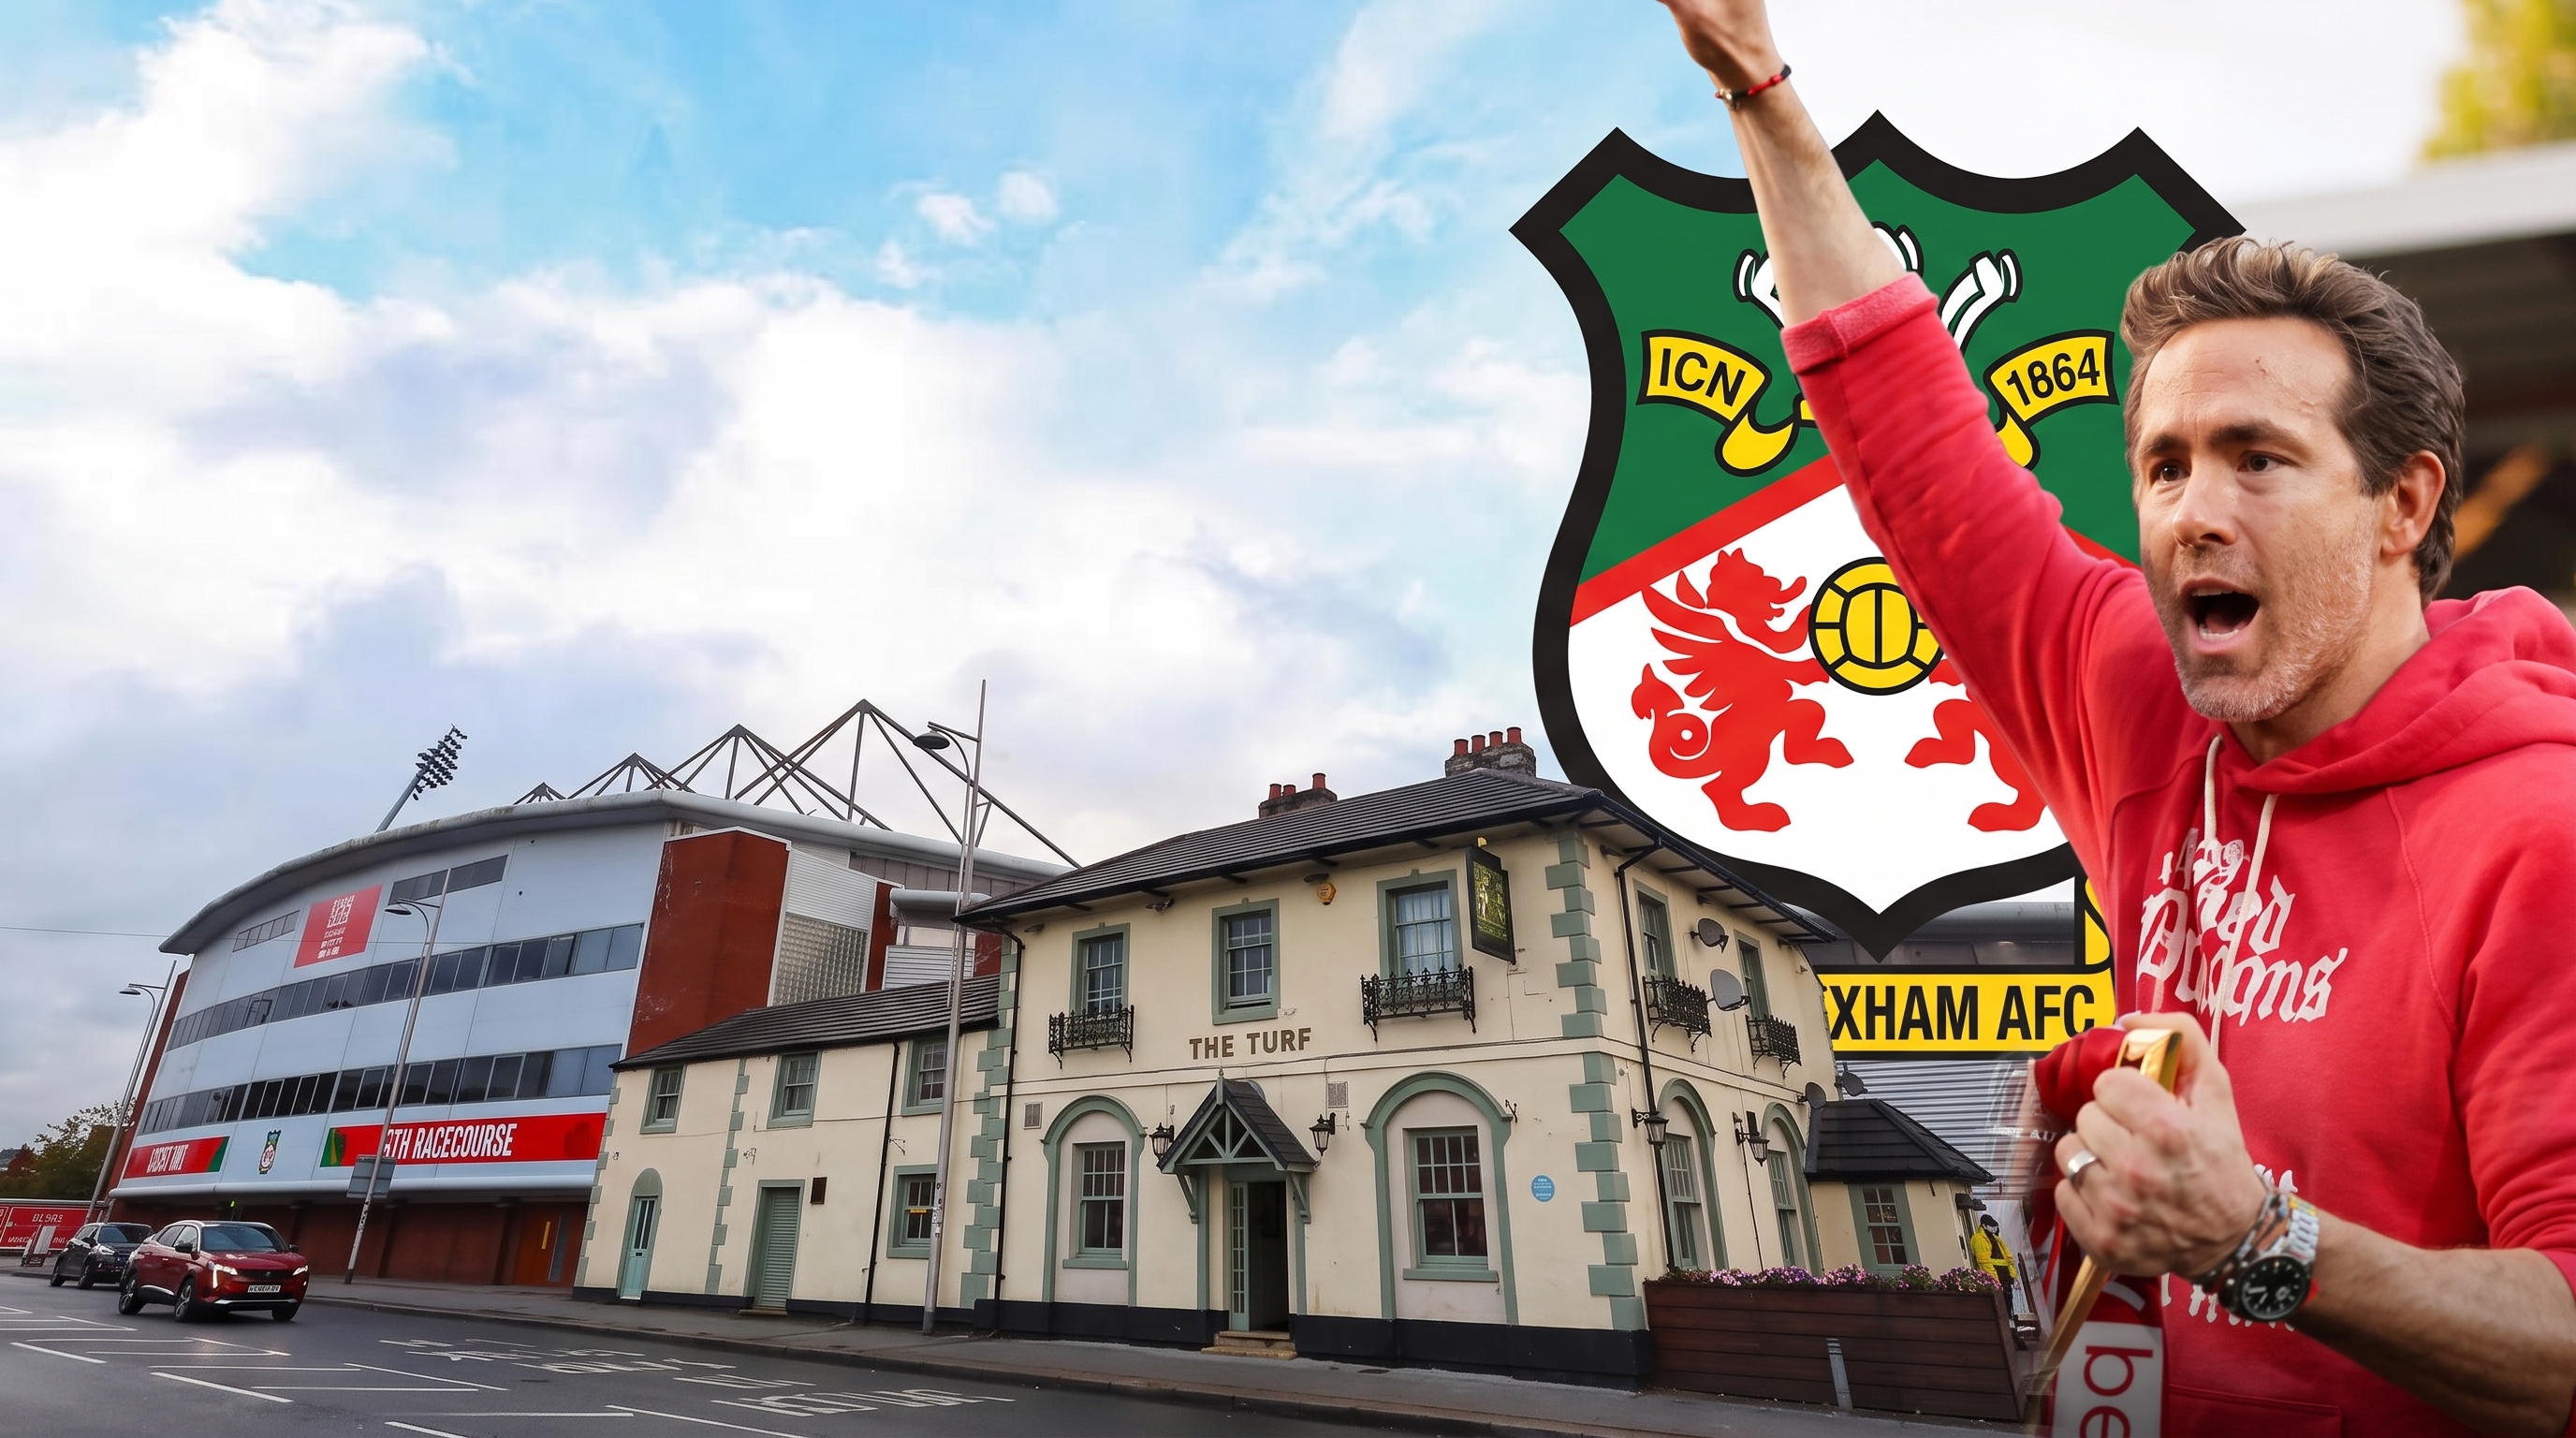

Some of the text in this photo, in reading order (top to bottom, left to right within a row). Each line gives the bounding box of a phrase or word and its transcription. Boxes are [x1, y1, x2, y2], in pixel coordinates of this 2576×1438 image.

[1189, 1027, 1311, 1060] THE TURF
[412, 1123, 518, 1159] RACECOURSE
